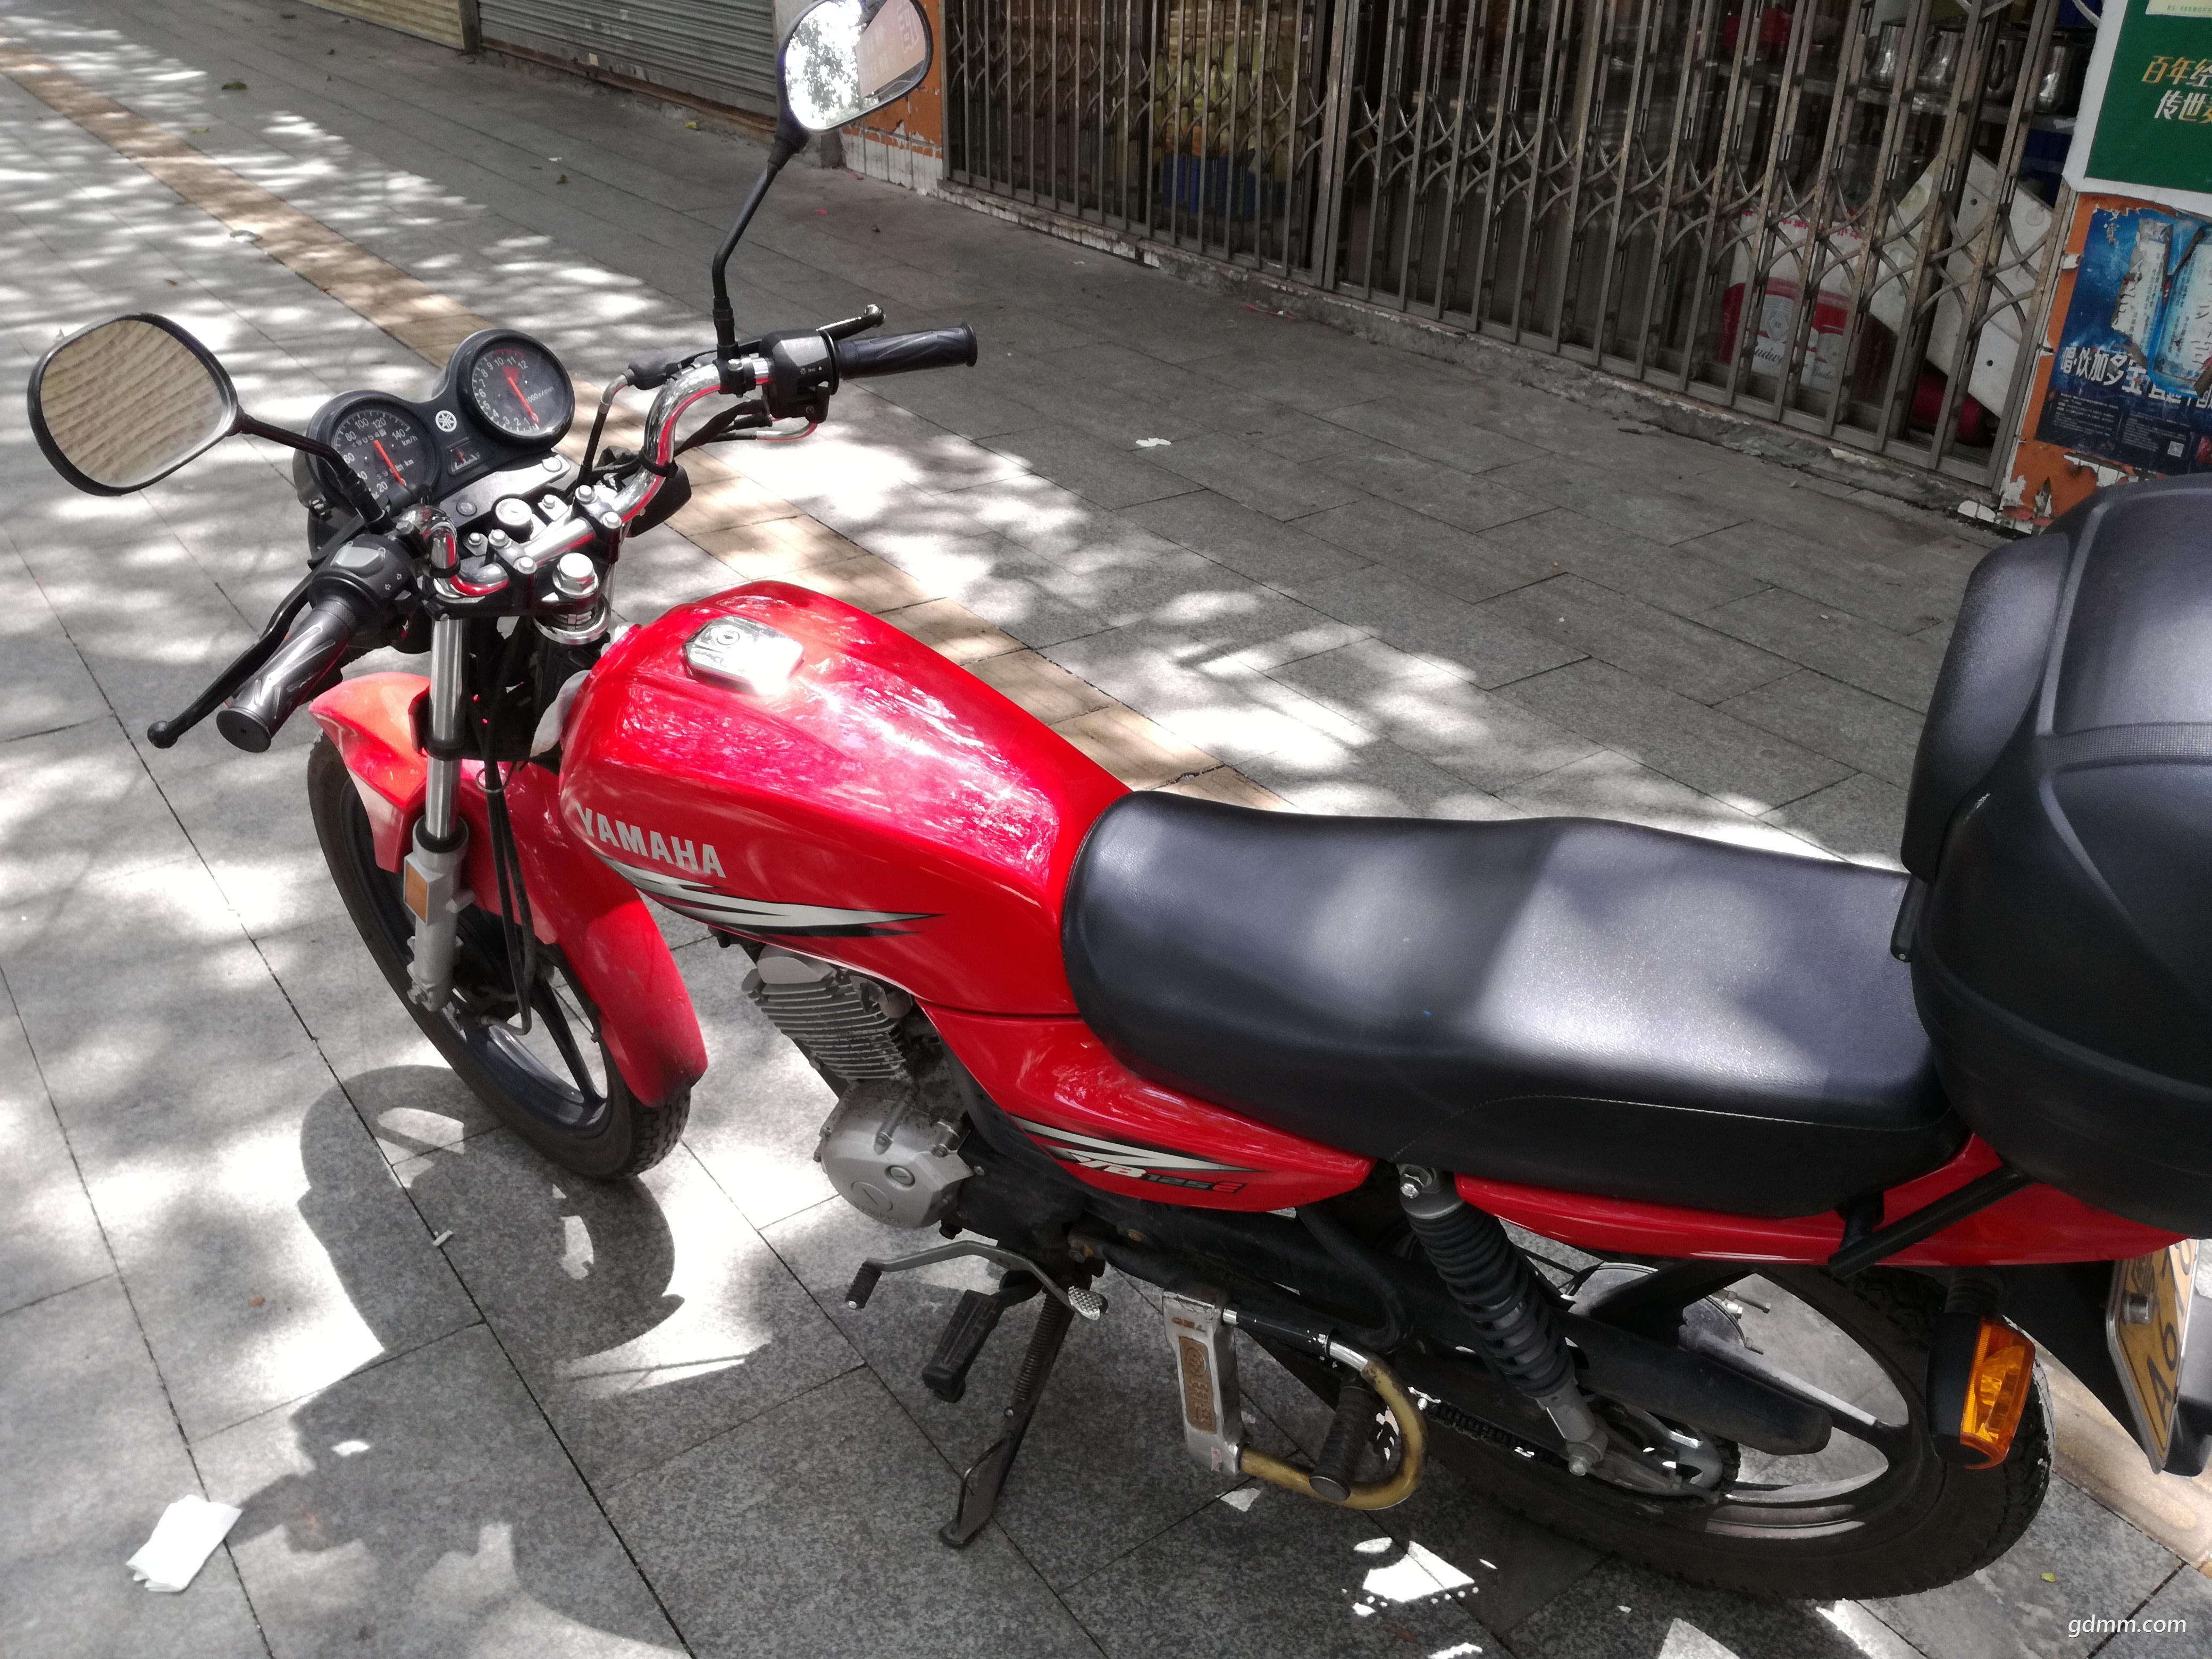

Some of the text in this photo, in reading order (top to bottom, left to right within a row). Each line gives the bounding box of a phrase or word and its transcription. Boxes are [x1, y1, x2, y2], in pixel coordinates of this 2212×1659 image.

[494, 357, 504, 367] 10
[507, 356, 517, 366] 11
[518, 360, 528, 370] 12
[487, 362, 493, 371] 9
[481, 368, 488, 378] 8
[479, 379, 485, 388] 7
[479, 388, 486, 398] 6
[483, 400, 490, 410] 5
[492, 408, 499, 417] 4
[355, 417, 369, 429] 100
[372, 417, 386, 429] 120
[503, 416, 510, 424] 3
[514, 417, 521, 426] 2
[345, 431, 356, 441] 80
[392, 429, 406, 440] 140
[401, 435, 418, 446] km/h
[343, 453, 355, 464] 60
[376, 481, 388, 492] 20
[575, 802, 727, 878] YAMAHA
